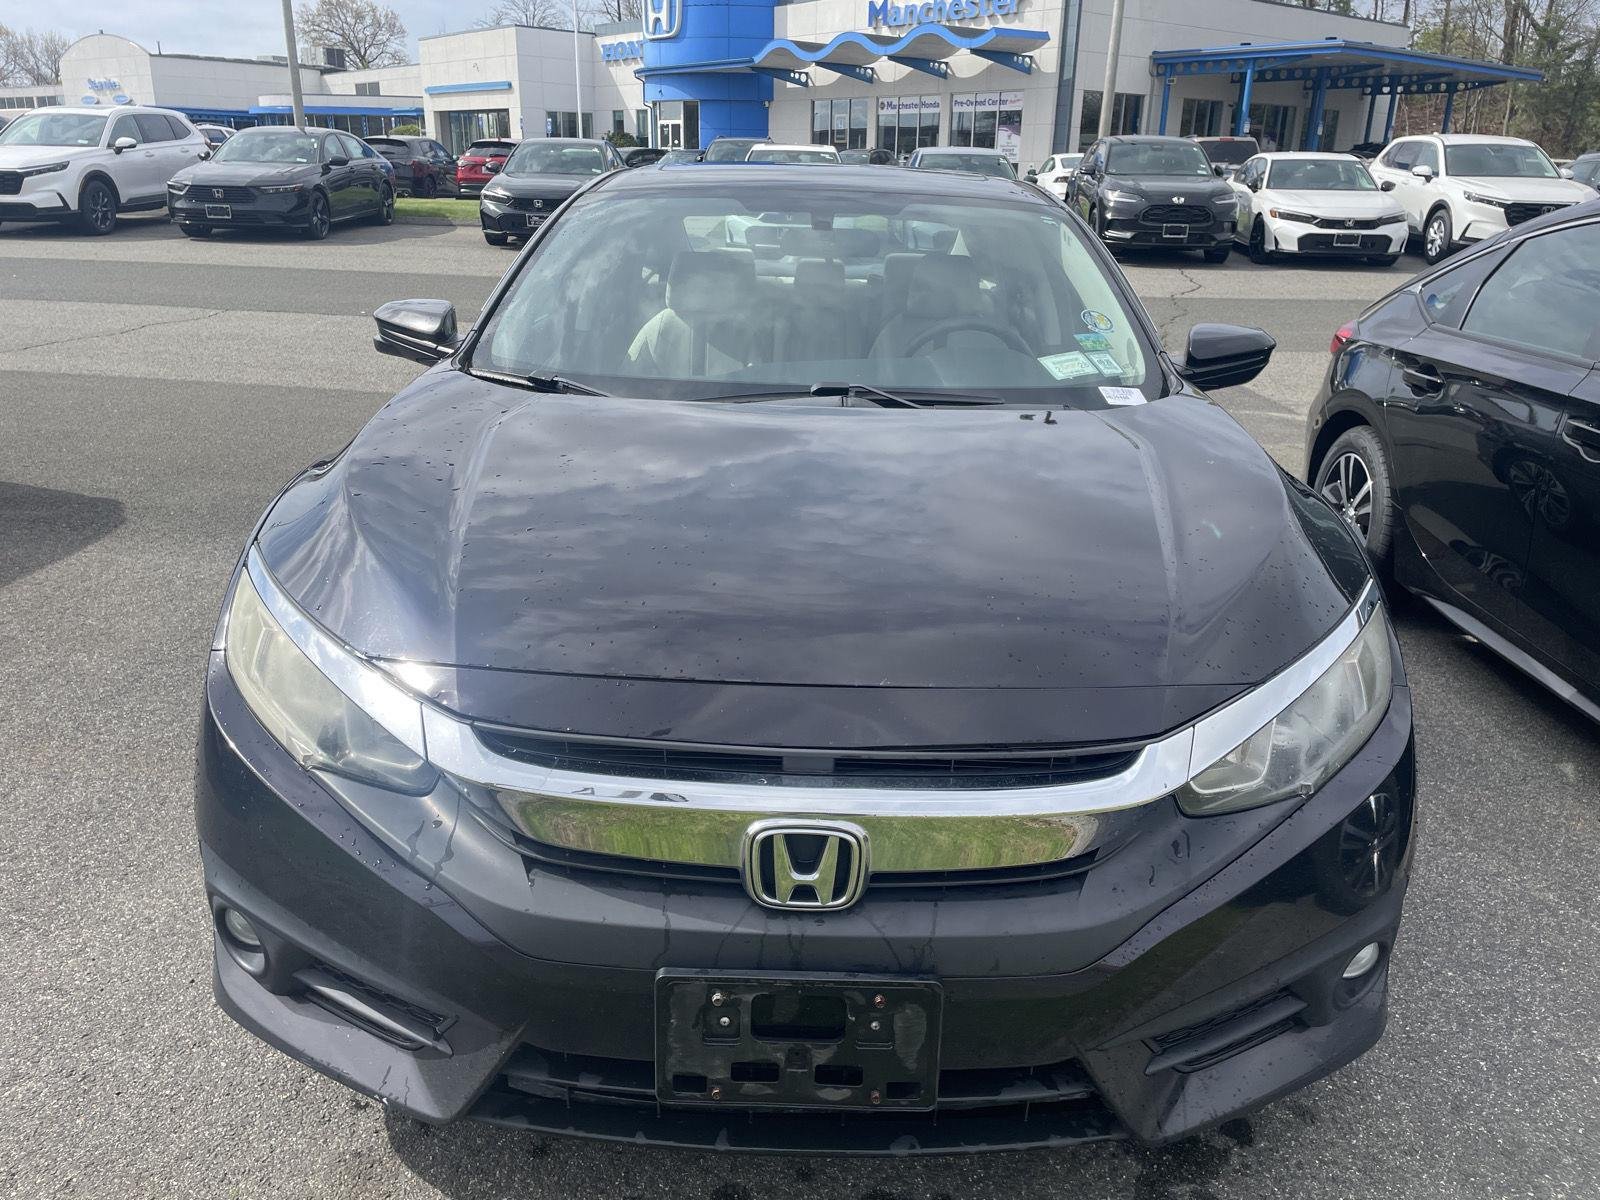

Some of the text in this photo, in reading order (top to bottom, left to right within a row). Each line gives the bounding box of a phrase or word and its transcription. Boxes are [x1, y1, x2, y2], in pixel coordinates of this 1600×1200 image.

[868, 0, 1018, 27] Manchester
[886, 100, 940, 110] Mancheste Honda
[954, 99, 986, 107] Pre-Owned
[987, 98, 1008, 106] Center
